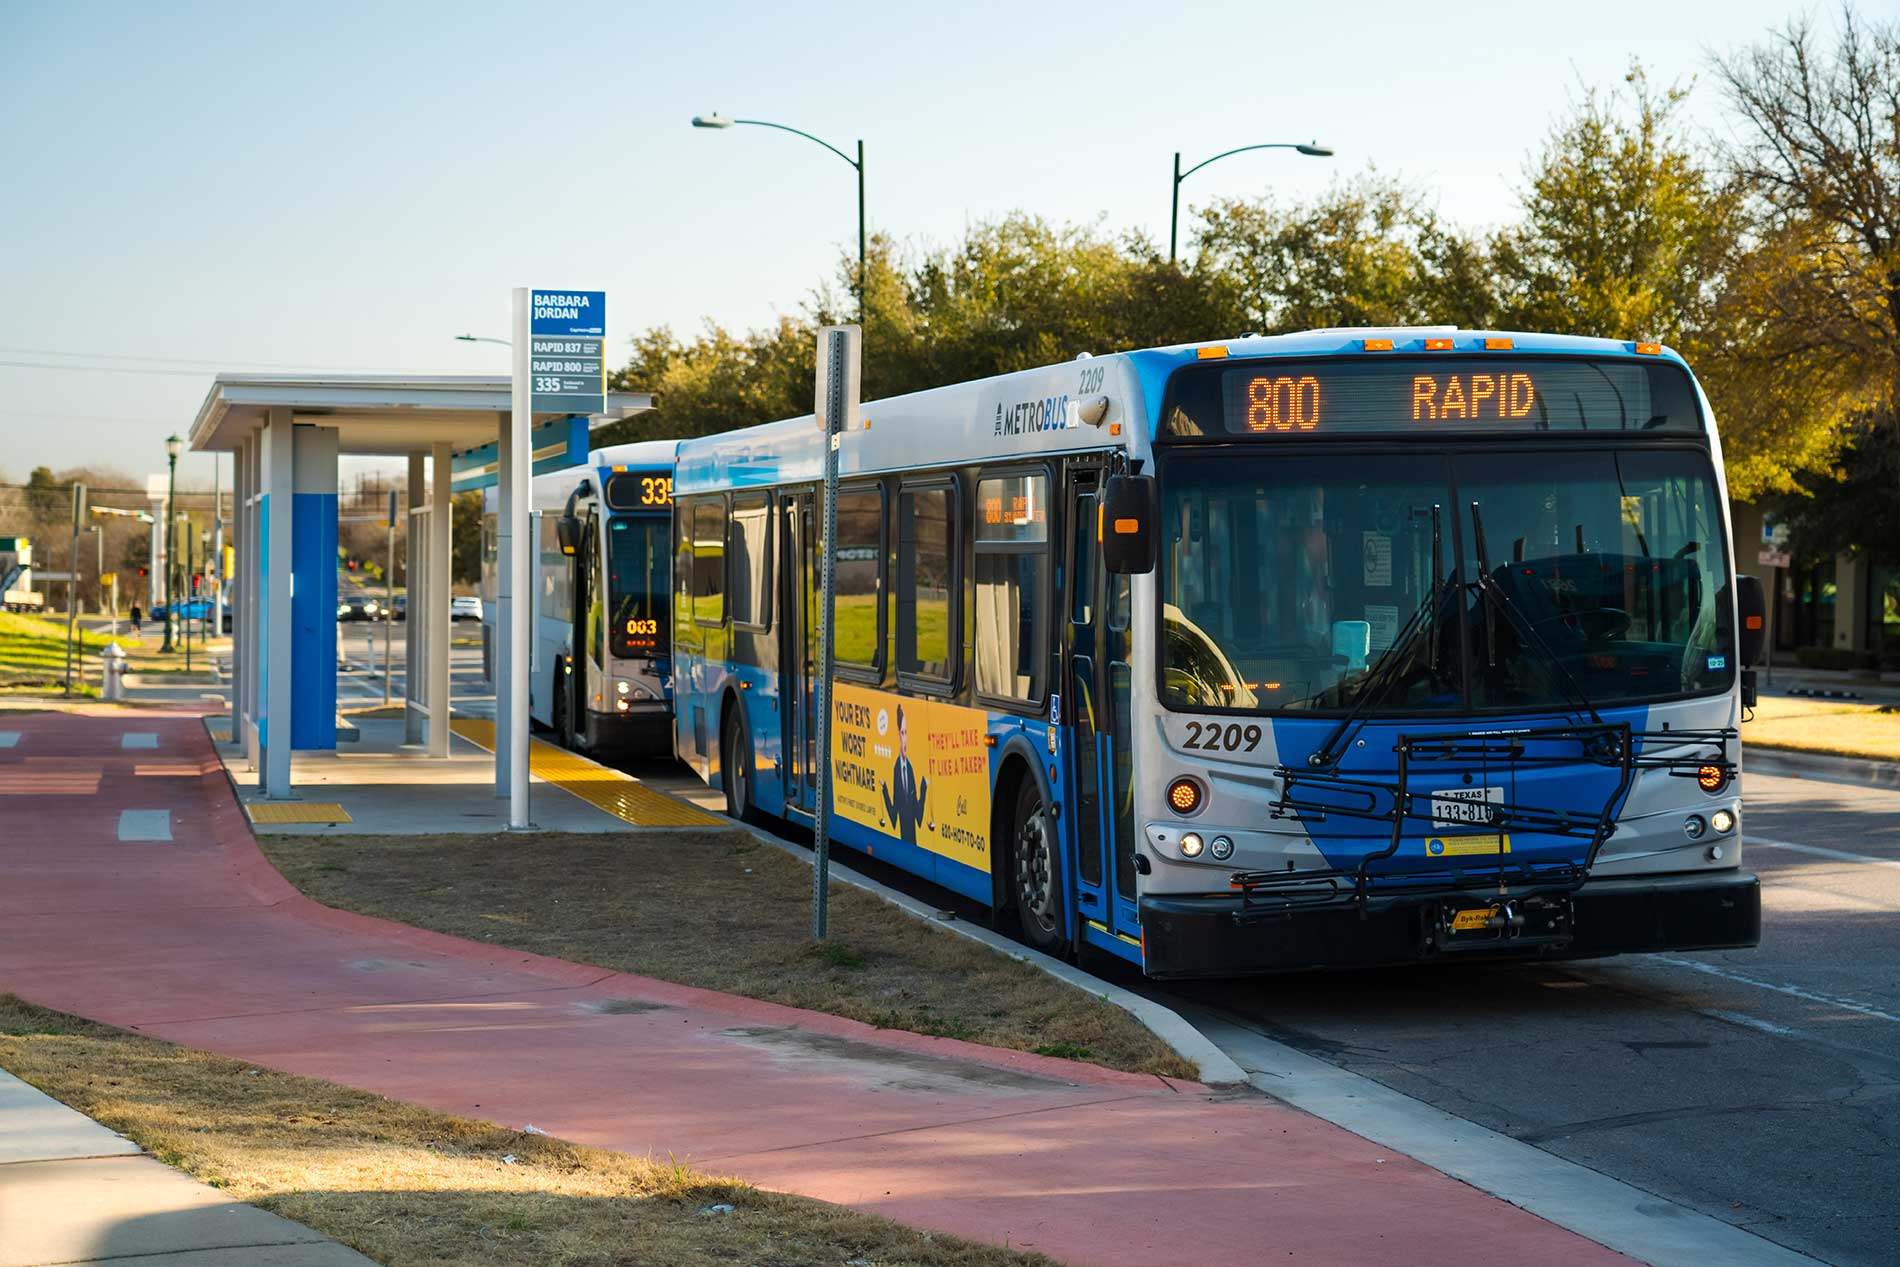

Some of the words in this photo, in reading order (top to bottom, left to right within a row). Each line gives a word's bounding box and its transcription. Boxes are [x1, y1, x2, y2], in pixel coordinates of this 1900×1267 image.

[534, 295, 590, 307] BARBARA
[534, 307, 579, 320] JORDAN
[533, 342, 563, 353] RAPID
[564, 343, 582, 353] 837
[532, 361, 563, 372] RAPID
[564, 362, 582, 372] 800
[535, 377, 561, 392] 335
[1078, 366, 1105, 395] 2209
[1248, 376, 1319, 431] 800
[1413, 374, 1534, 420] RAPID
[1003, 395, 1068, 436] METROBUS
[834, 699, 854, 725] YOUR
[855, 704, 871, 729] EX'S
[841, 731, 866, 758] WORST
[928, 732, 960, 751] "THEY'LL
[960, 729, 978, 747] TAKE
[1182, 721, 1263, 752] 2209
[834, 759, 876, 792] NIGHTMARE
[937, 759, 952, 777] LIKE
[953, 758, 960, 776] A
[1453, 791, 1482, 799] TEXAS
